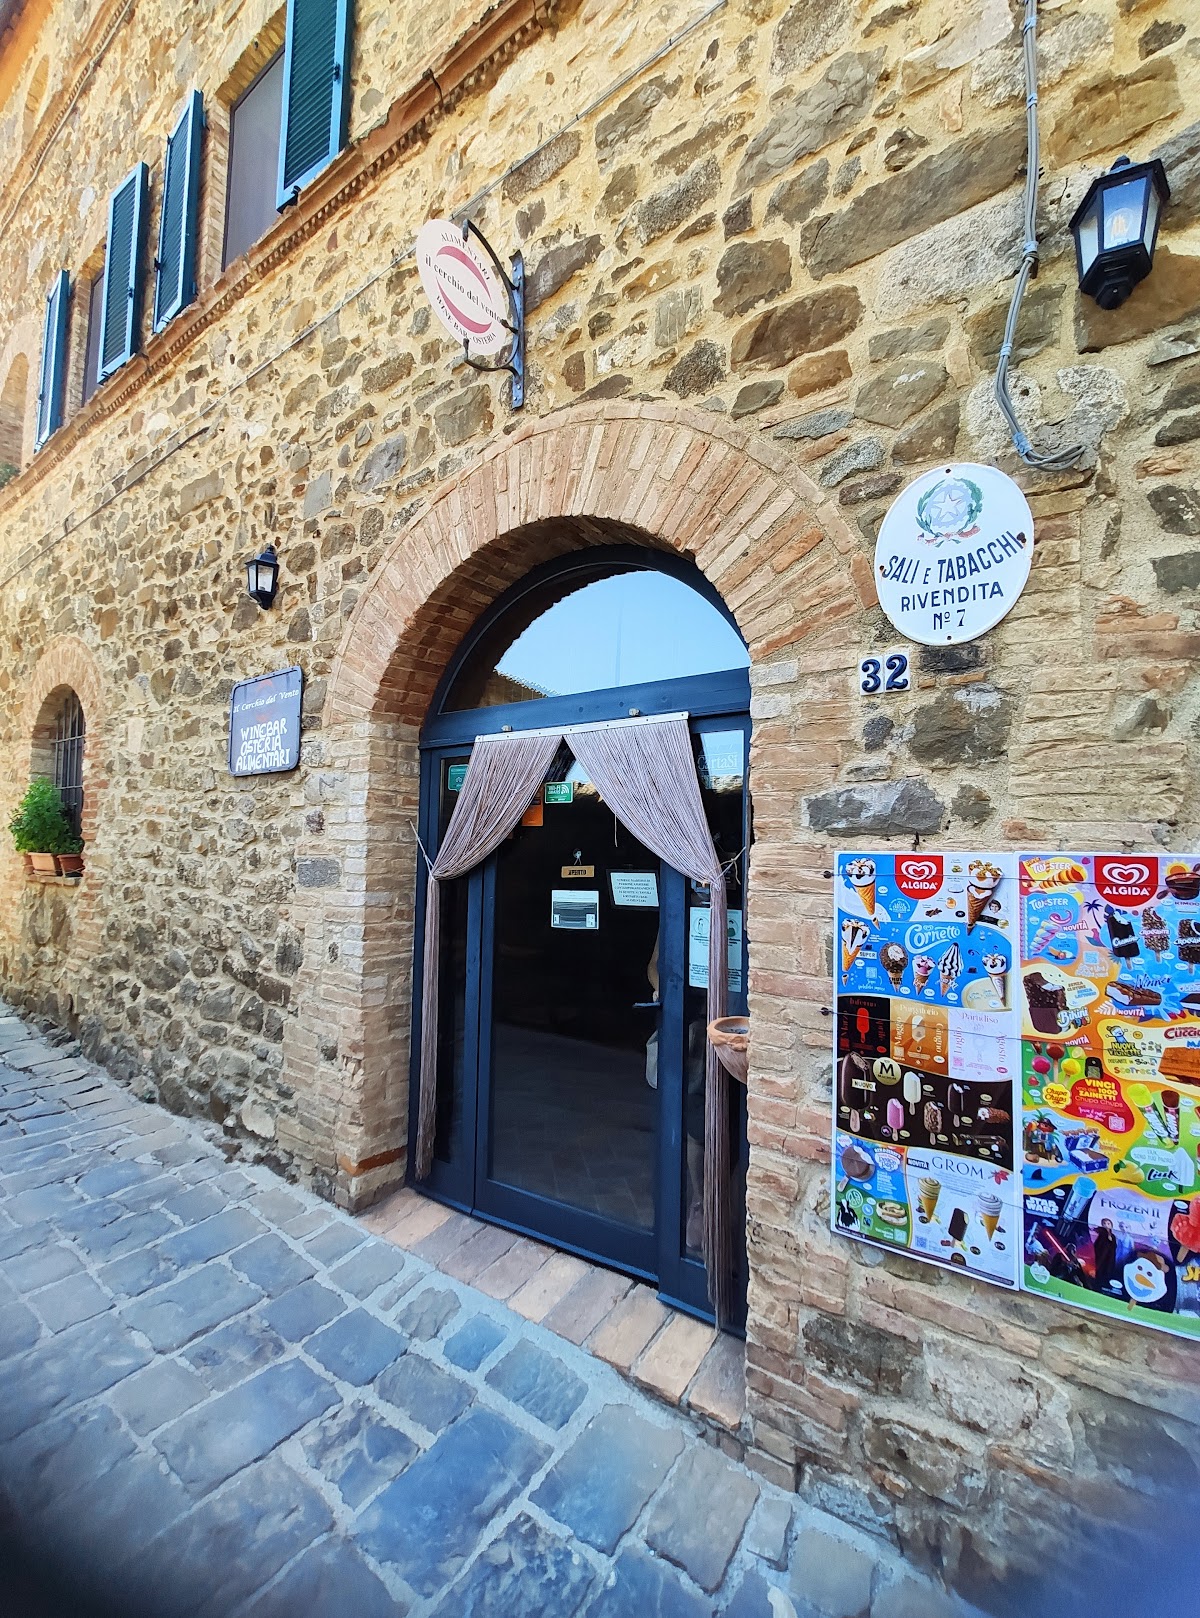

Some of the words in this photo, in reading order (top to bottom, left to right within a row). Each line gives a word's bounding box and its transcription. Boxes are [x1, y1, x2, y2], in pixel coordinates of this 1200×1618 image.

[425, 254, 431, 267] il
[434, 264, 465, 294] cerchio
[467, 290, 479, 306] del
[481, 301, 502, 324] vento
[436, 295, 453, 324] WINE
[453, 323, 468, 340] BAR
[473, 332, 497, 346] OSTERIA
[882, 555, 921, 585] SALI
[923, 567, 932, 585] E
[937, 531, 1025, 584] TABACCHI
[901, 581, 1004, 612] RIVENDITA
[956, 608, 966, 628] 7
[861, 653, 909, 693] 32
[242, 698, 265, 711] Cerchio
[266, 694, 278, 705] del
[279, 689, 299, 700] Vento
[240, 717, 288, 741] WINEBAR
[240, 735, 282, 757] OSTERIA
[235, 748, 291, 772] ALIMENTARI
[901, 881, 937, 890] ALGIDA
[1103, 886, 1150, 896] ALGIDA
[1063, 919, 1089, 932] NOVITÀ
[905, 924, 961, 954] Cornetto
[1057, 1006, 1089, 1027] Bikini
[1118, 1006, 1145, 1016] NOVITÀ
[1065, 1034, 1090, 1046] NOVITÀ
[880, 1061, 895, 1077] M
[854, 1080, 874, 1090] NUOVO
[1084, 1078, 1116, 1090] VINCI
[1098, 1088, 1118, 1096] 1000
[1075, 1095, 1098, 1104] Chupa
[1099, 1099, 1124, 1108] Chups
[1079, 1090, 1116, 1101] ZAINETTI
[932, 1156, 985, 1180] GROM
[1026, 1196, 1057, 1207] STAR
[1026, 1203, 1059, 1215] WARS
[1101, 1198, 1149, 1215] FROZEN
[1150, 1208, 1161, 1219] II
